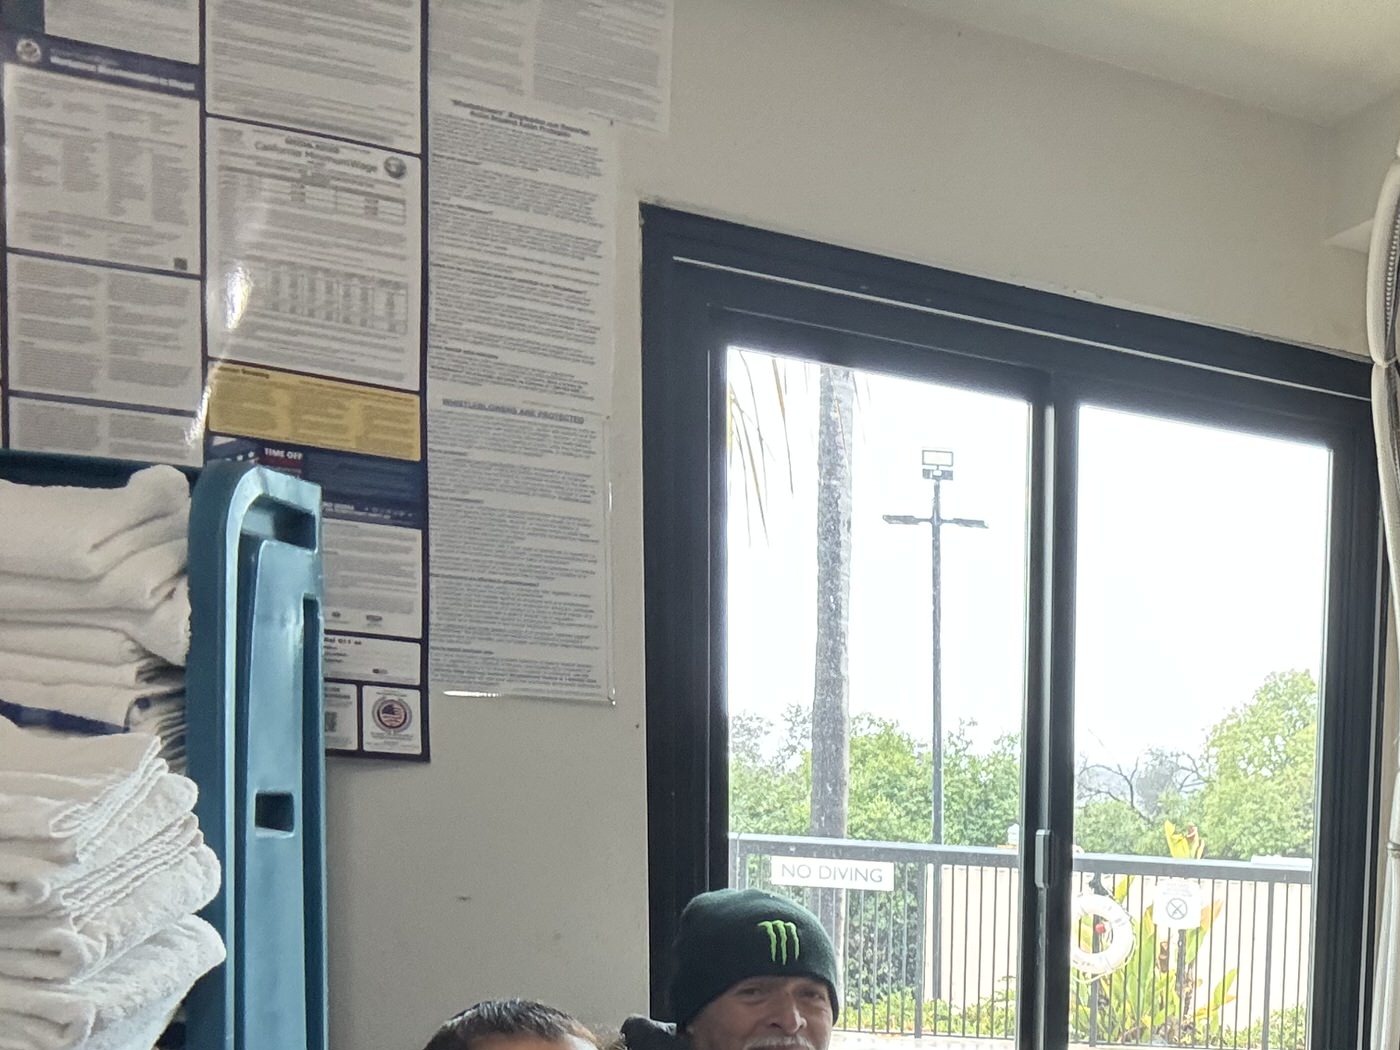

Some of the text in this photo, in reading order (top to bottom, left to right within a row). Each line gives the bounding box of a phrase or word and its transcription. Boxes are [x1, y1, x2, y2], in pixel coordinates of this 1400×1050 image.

[264, 447, 303, 460] TIME OFF
[781, 863, 883, 883] NO DIVING
